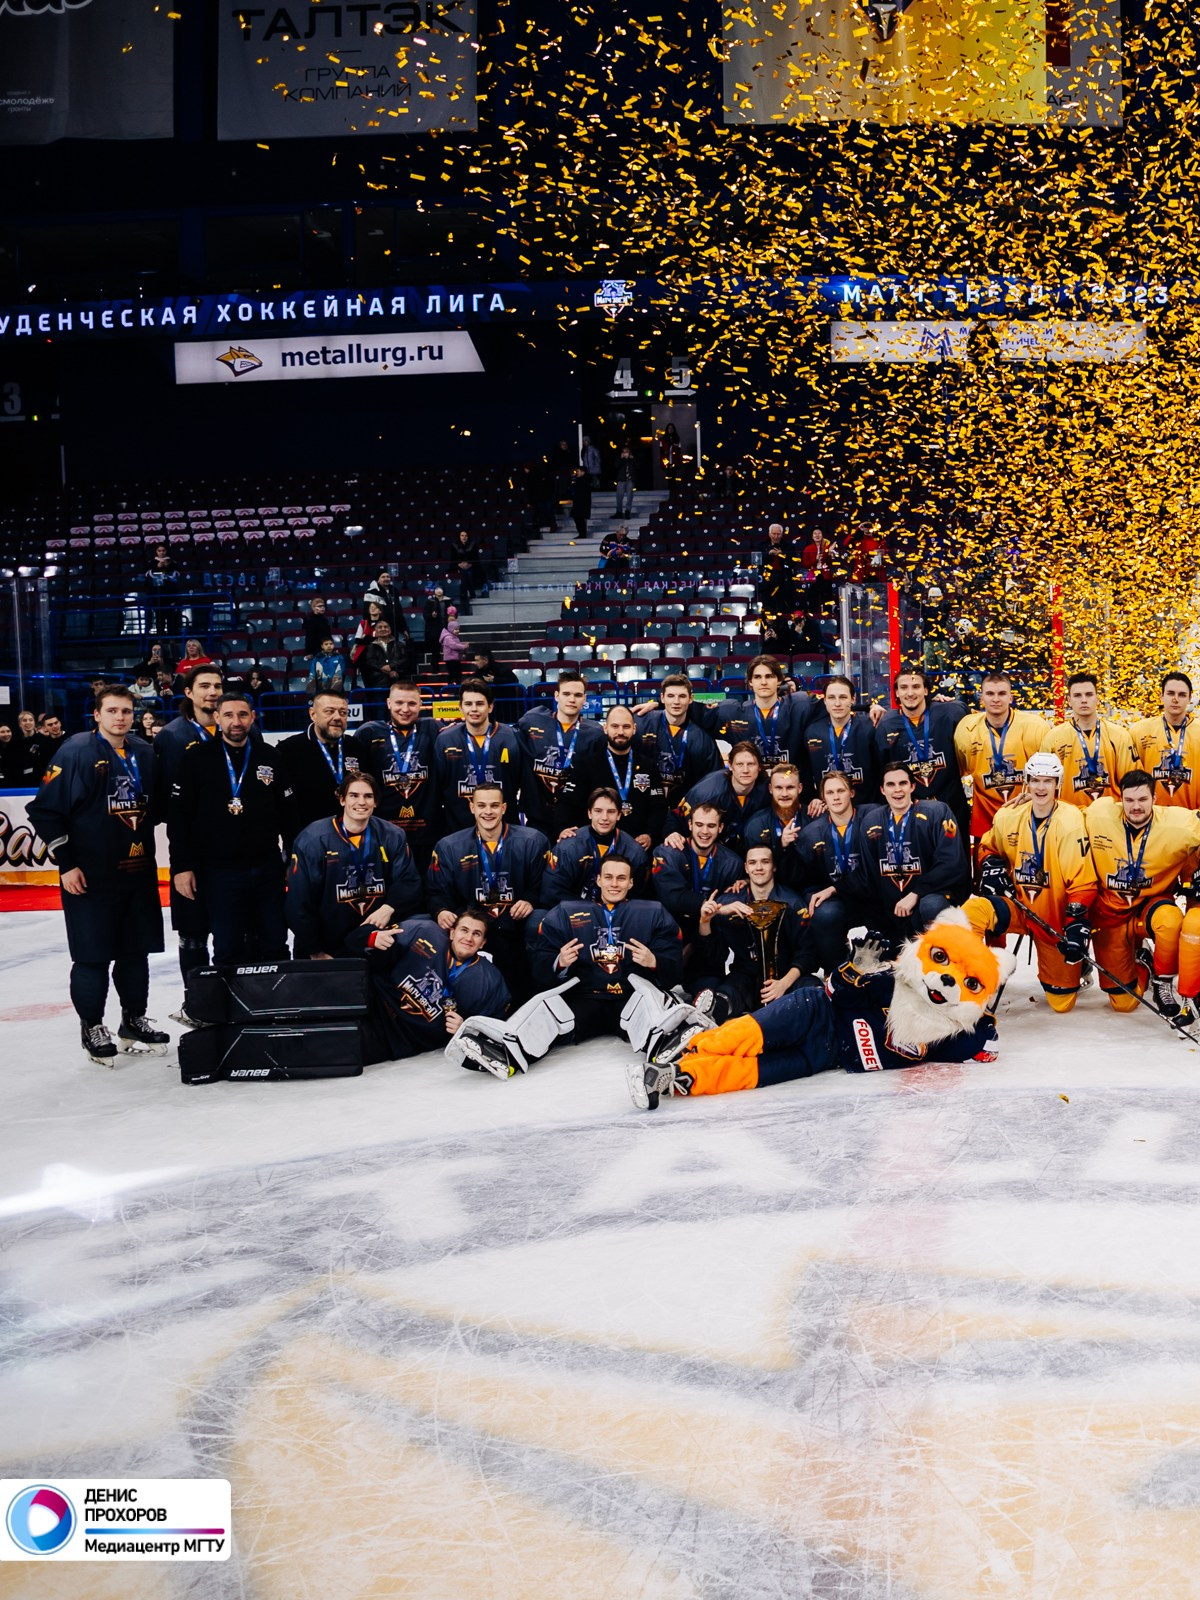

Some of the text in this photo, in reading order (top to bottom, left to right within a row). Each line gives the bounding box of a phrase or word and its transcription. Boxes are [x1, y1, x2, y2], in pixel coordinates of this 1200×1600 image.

[232, 1, 465, 41] ТАЛТЭК
[304, 65, 391, 82] ГРУППА
[284, 80, 411, 102] КОМПАНИЙ
[217, 295, 406, 322] ХОККЕЙНАЯ
[426, 293, 506, 314] ЛИГА
[281, 343, 444, 368] metallurg.ru
[613, 358, 634, 389] 4
[671, 356, 691, 389] 5
[3, 382, 22, 414] 3
[236, 965, 278, 975] BAUER
[856, 1020, 880, 1071] FONBET
